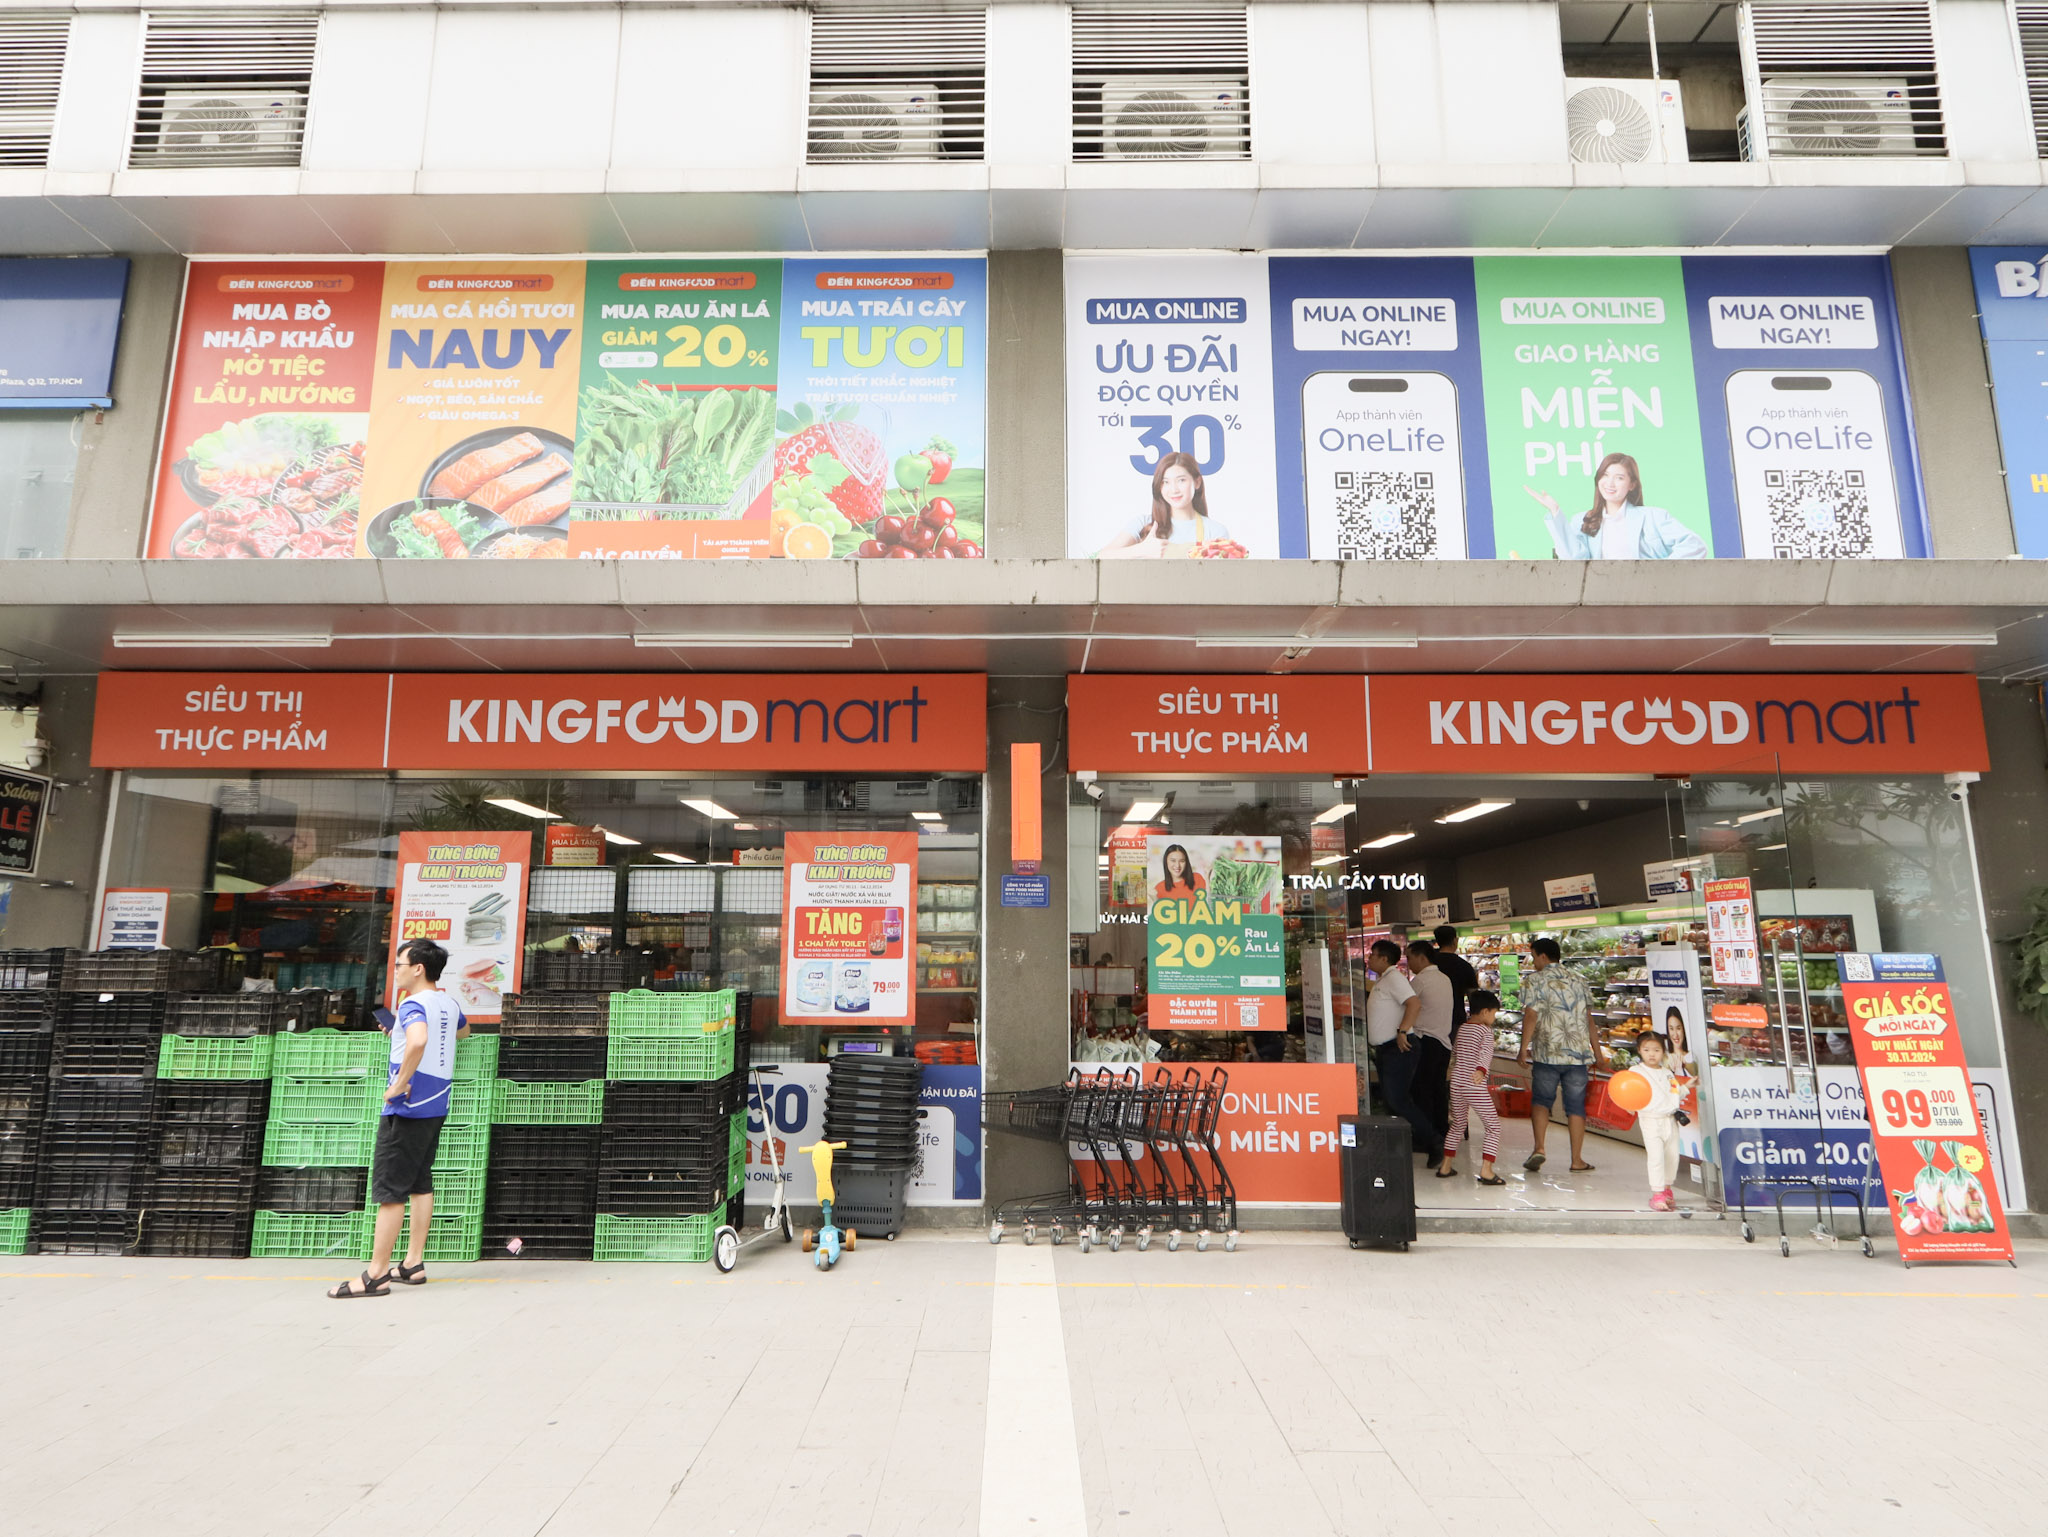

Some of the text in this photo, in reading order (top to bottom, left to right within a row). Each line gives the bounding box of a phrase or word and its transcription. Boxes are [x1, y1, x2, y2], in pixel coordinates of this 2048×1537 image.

[229, 278, 254, 289] ĐẾN
[428, 278, 453, 289] ĐẾN
[233, 299, 331, 321] MUA BÒ
[391, 296, 575, 319] MUA CÁ HỒI TƯƠI
[602, 299, 770, 319] MUA RAU ĂN LÁ
[801, 296, 967, 317] MUA TRÁI CÂY
[1096, 301, 1239, 320] MUA ONLINE
[1303, 305, 1447, 322] MUA ONLINE
[1512, 301, 1657, 319] MUA ONLINE
[202, 322, 354, 355] NHẬP KHẨU
[602, 324, 768, 368] GIẢM 20%
[801, 325, 964, 368] TƯƠI
[1341, 330, 1411, 346] NGAY!
[388, 328, 572, 369] NAUY
[1096, 335, 1238, 373] ƯU ĐÃI
[1514, 339, 1660, 363] GIAO HÀNG
[223, 352, 325, 382] MỞ TIỆC
[433, 375, 520, 388] GIÁ LUÔN TỐT
[807, 372, 957, 389] THỜI TIẾT KHẮC NGHIỆT
[260, 382, 355, 405] NƯỚNG
[1098, 377, 1239, 407] ĐỘC QUYỀN
[1520, 368, 1664, 429] MIỄN
[461, 410, 520, 420] OMEGA-3
[1336, 408, 1423, 423] App thành viên
[1098, 411, 1242, 476] TỚI 30%
[1319, 427, 1445, 452] OneLife
[1746, 425, 1873, 450] OneLife
[1524, 430, 1605, 476] PHÍ
[185, 685, 303, 718] SIÊU THỊ
[1158, 686, 1279, 720] SIÊU THỊ
[155, 721, 327, 757] THỰC PHẨM
[1131, 724, 1308, 759] THỰC PHẨM
[428, 844, 500, 862] TƯNG BỪNG
[815, 844, 887, 862] TƯNG BỪNG
[420, 862, 505, 880] KHAI TRƯƠNG
[808, 862, 893, 880] KHAI TRƯƠNG
[1288, 871, 1426, 890] TRÁI CÂY TƯƠI
[406, 908, 435, 917] ĐỒNG GIÁ
[1153, 890, 1241, 926] GIẢM
[805, 908, 862, 938] TẶNG
[1120, 912, 1140, 924] HẢI
[404, 920, 449, 939] 29.000
[1244, 928, 1267, 938] Rau
[1155, 933, 1241, 968] 20%
[1244, 940, 1280, 952] Ăn Lá
[873, 982, 901, 993] 79.000
[1169, 997, 1217, 1008] ĐẶC QUYỀN
[1169, 1007, 1217, 1016] THÀNH VIÊN
[1853, 986, 1947, 1019] GIÁ SỐC
[1879, 1014, 1937, 1033] MỖI NGÀY
[1871, 1037, 1944, 1051] DUY NHẤT NGÀY
[1886, 1052, 1937, 1063] 30.11.2024
[943, 1087, 977, 1098] ƯU ĐÃI
[1730, 1085, 1789, 1102] BẠN TẢI
[1221, 1093, 1320, 1114] ONLINE
[1733, 1106, 1861, 1120] APP THÀNH VIÊN
[1882, 1089, 1956, 1129] 99.000
[1932, 1104, 1959, 1116] Đ/TÚI
[1230, 1121, 1300, 1153] MIỄN
[1735, 1140, 1806, 1166] Giảm
[1840, 1175, 1882, 1187] trên App
